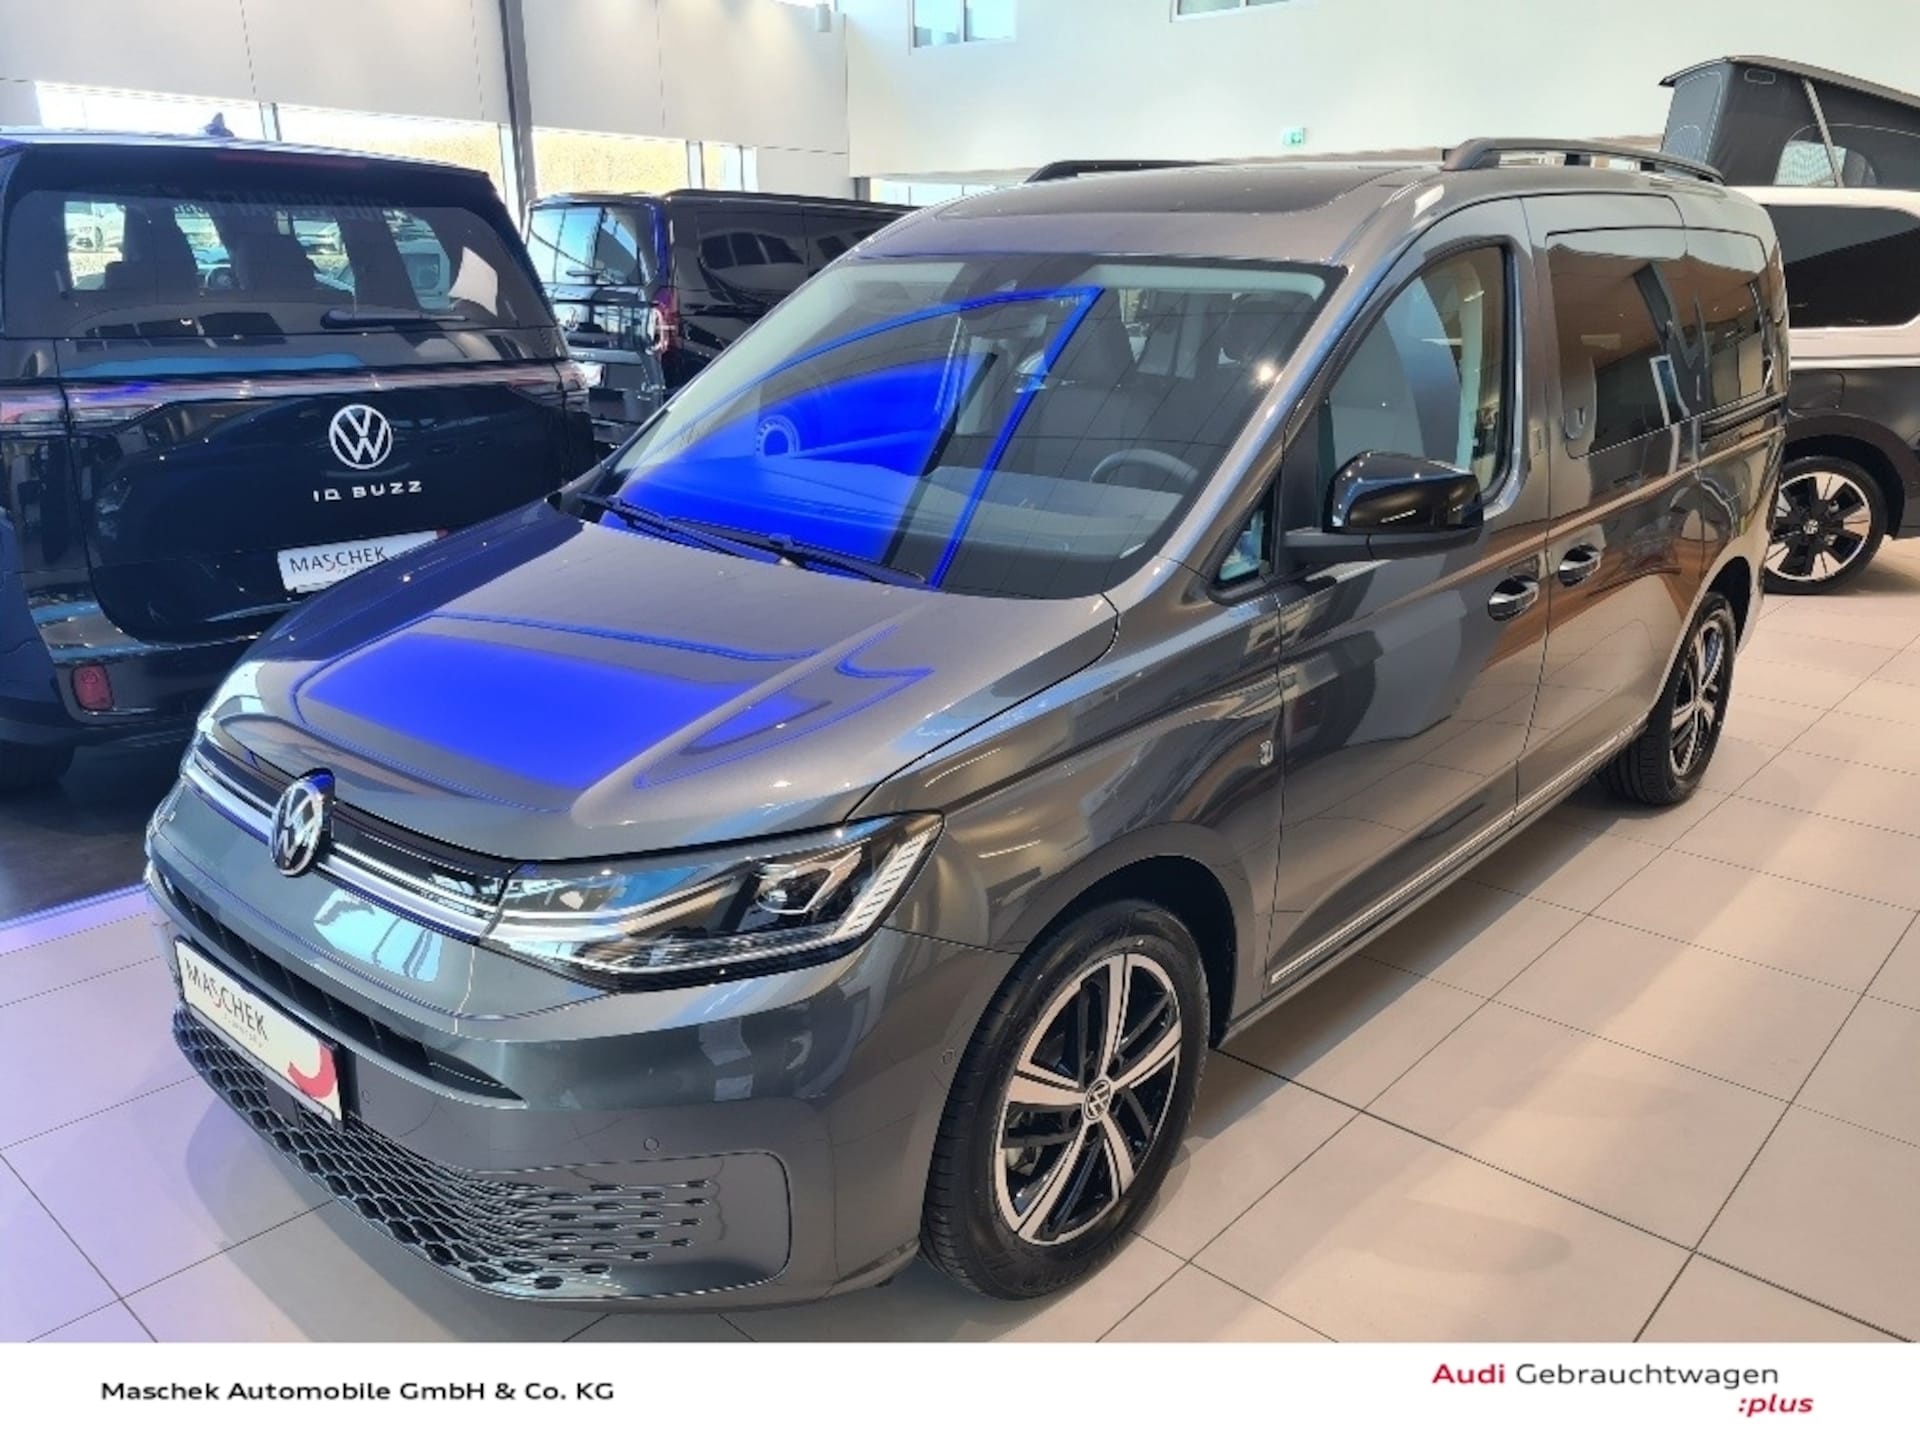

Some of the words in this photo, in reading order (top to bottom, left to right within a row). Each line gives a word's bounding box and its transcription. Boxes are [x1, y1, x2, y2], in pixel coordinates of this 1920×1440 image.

[352, 481, 422, 498] BUZZ
[289, 546, 389, 573] MASCHEK
[184, 957, 269, 1041] MASCHEK
